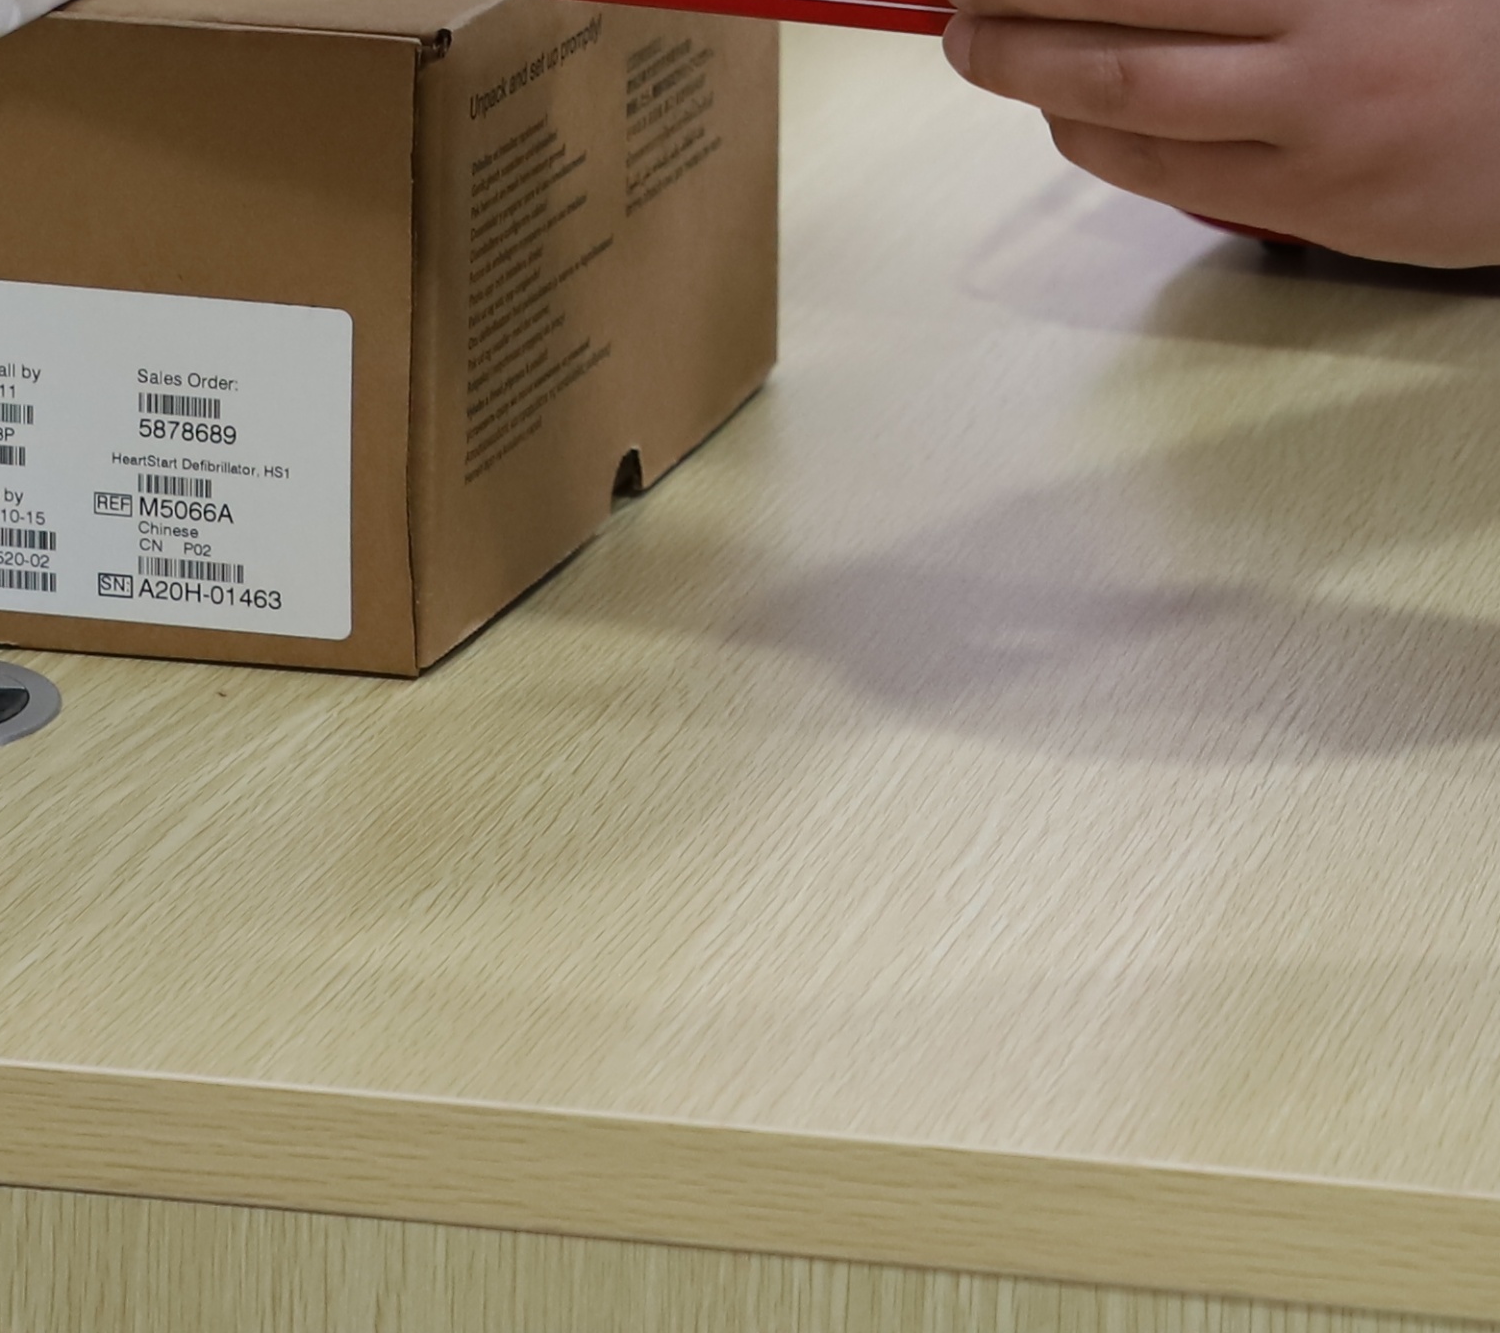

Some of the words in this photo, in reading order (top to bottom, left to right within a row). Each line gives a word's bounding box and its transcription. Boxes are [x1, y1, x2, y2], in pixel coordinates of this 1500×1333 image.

[22, 364, 41, 383] by
[138, 369, 182, 386] Sales
[188, 373, 238, 391] Order:
[139, 419, 236, 445] 5878689
[112, 452, 177, 469] HeartStart
[264, 466, 289, 478] HS1
[4, 488, 23, 506] by
[97, 494, 130, 514] REF
[140, 496, 233, 524] M5066A
[138, 521, 198, 538] Chinese
[139, 538, 162, 552] CN
[184, 542, 211, 557] P02
[139, 579, 281, 610] A20H-01463
